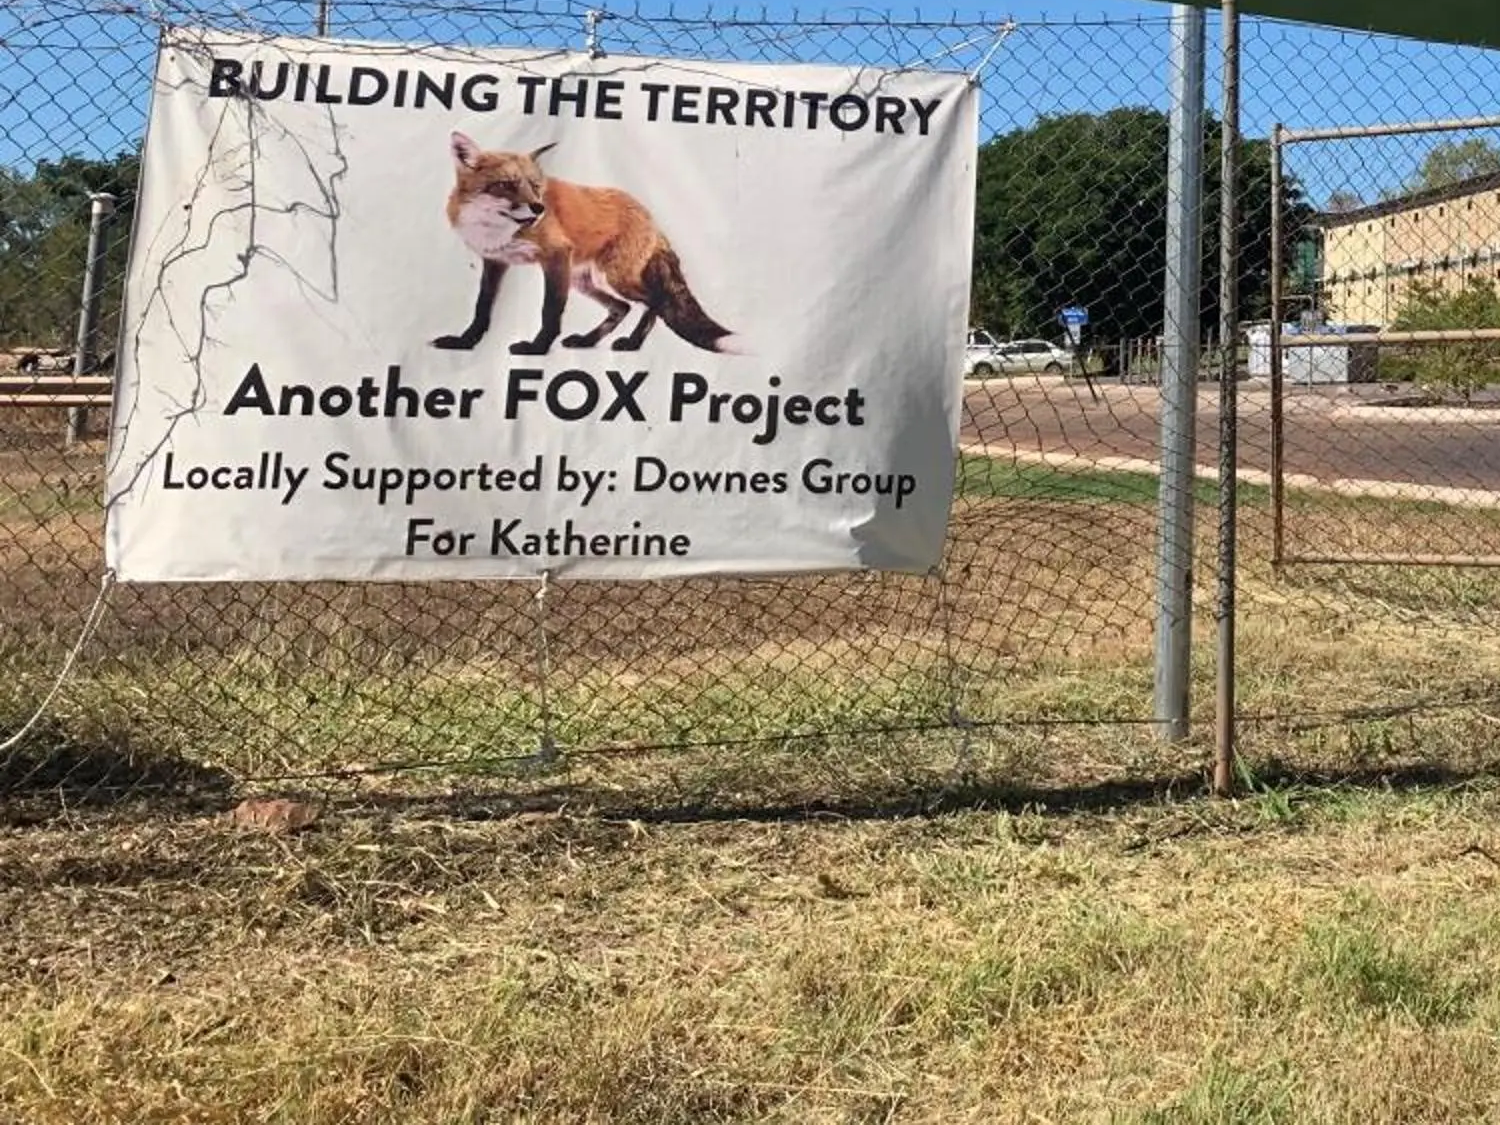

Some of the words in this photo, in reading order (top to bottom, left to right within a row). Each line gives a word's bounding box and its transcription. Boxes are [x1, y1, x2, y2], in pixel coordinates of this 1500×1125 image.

[209, 59, 498, 112] BUILDING
[518, 75, 623, 120] THE
[642, 84, 941, 136] TERRITORY
[225, 364, 483, 421] Another
[505, 369, 648, 422] FOX
[671, 373, 865, 445] Project
[164, 452, 307, 504] Locally
[323, 453, 541, 505] Supported
[557, 458, 617, 507] by:
[634, 457, 788, 495] Downes
[802, 459, 916, 508] Group
[405, 519, 474, 557] For
[490, 519, 691, 557] Katherine
